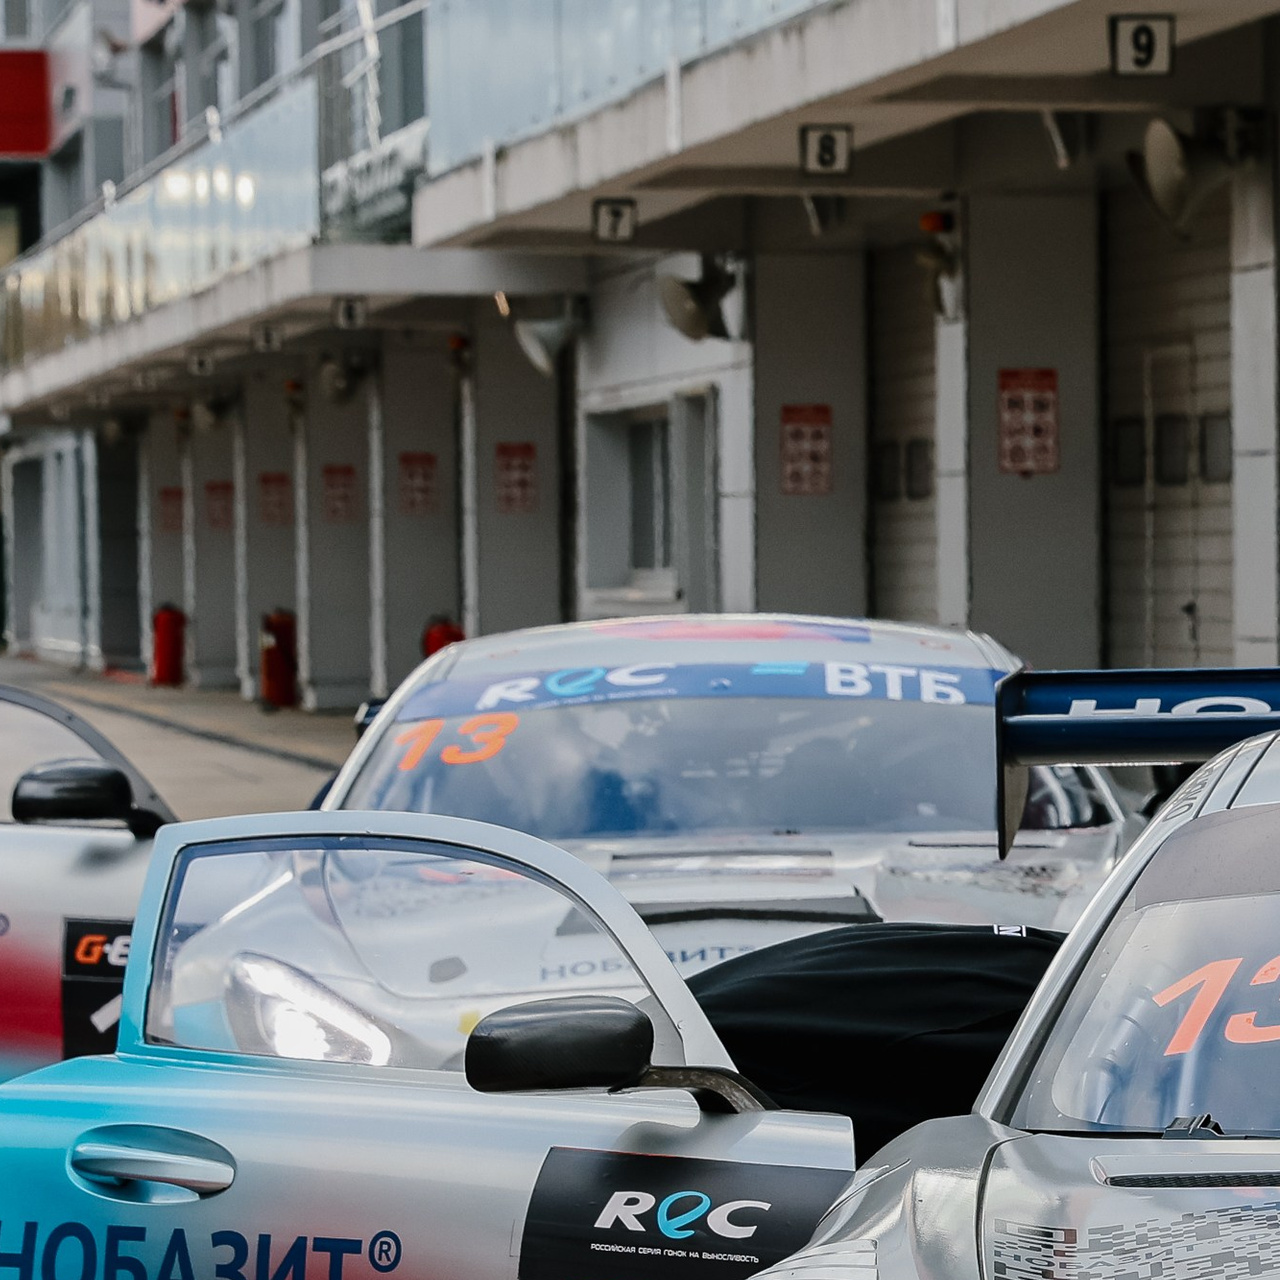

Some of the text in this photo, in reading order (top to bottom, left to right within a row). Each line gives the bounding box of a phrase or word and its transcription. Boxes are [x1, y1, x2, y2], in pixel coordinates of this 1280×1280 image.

[1131, 24, 1155, 67] 9
[818, 134, 836, 169] 8
[825, 660, 967, 706] ВТБ
[394, 711, 520, 772] 13
[590, 1243, 760, 1264] РОССИЙСКАЯ СЕРИЯ ГОНОК НА ВЫНОСЛИВОСТЬ
